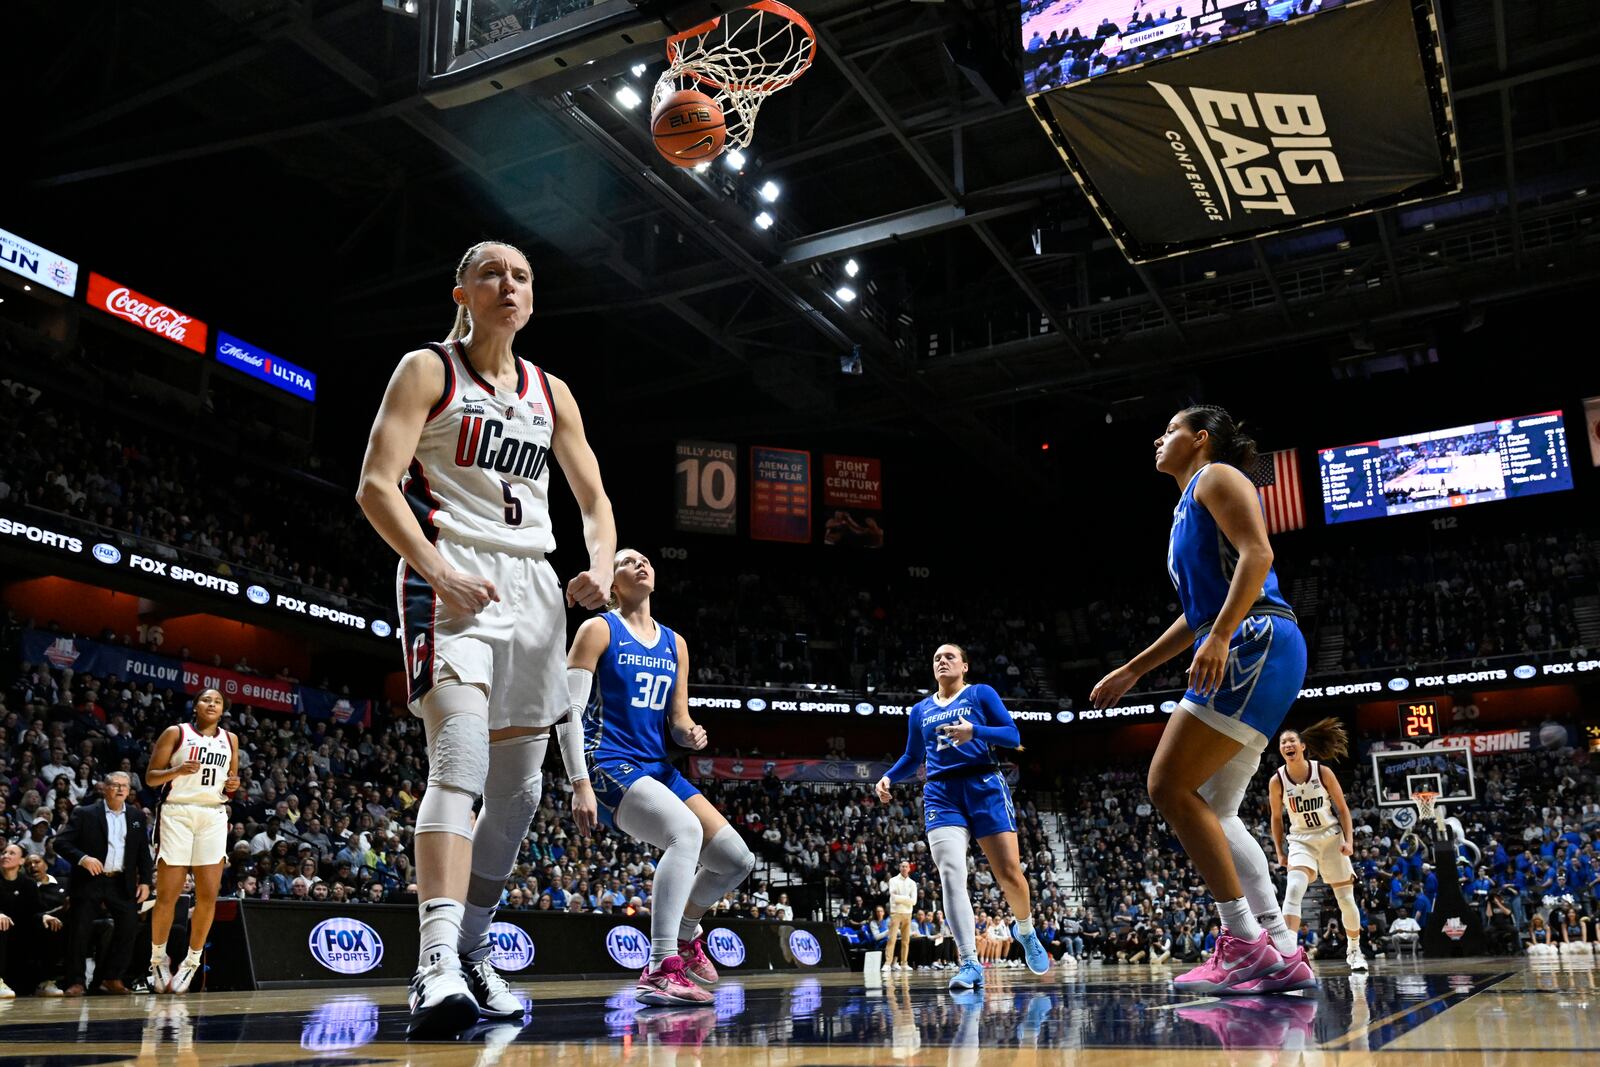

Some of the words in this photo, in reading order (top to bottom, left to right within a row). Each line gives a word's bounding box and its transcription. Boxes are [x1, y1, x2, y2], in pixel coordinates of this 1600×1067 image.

[1129, 30, 1165, 45] CREIGHTON
[1174, 22, 1186, 32] 22
[1255, 92, 1344, 184] BIG
[1189, 87, 1296, 215] EAST
[1165, 130, 1223, 222] CONFERENCE
[106, 287, 192, 342] Coca-Cola
[219, 342, 263, 368] Michelob
[272, 362, 312, 391] ULTRA
[463, 407, 485, 415] CHANGE
[455, 415, 548, 481] UConn
[707, 448, 735, 460] JOEL
[758, 461, 789, 471] ARENA
[790, 463, 803, 472] OF
[760, 469, 777, 479] THE
[778, 471, 803, 481] YEAR
[835, 460, 870, 473] FIGHT
[851, 471, 867, 480] THE
[675, 458, 737, 510] 10
[826, 476, 880, 492] CENTURY
[499, 479, 523, 526] 5
[0, 517, 83, 553] SPORTS
[660, 546, 688, 560] 109
[129, 554, 168, 576] FOX
[170, 565, 240, 595] SPORTS
[908, 566, 930, 578] 110
[276, 594, 307, 614] FOX
[309, 603, 366, 630] SPORTS
[136, 624, 165, 646] 16
[617, 653, 677, 673] CREIGHTON
[1543, 662, 1575, 675] FOX
[125, 659, 179, 681] FOLLOW
[182, 671, 199, 685] US
[203, 676, 221, 690] ON
[242, 683, 299, 705] @BIGEAST
[1415, 675, 1445, 687] FOX
[1447, 669, 1508, 684] SPORTS
[631, 671, 672, 711] 30
[1296, 687, 1323, 699] FOX
[1325, 681, 1382, 697] SPORTS
[688, 697, 742, 709] SPORTS
[771, 701, 797, 711] FOX
[799, 701, 851, 713] SPORTS
[879, 705, 903, 715] FOX
[1079, 709, 1103, 720] FOX
[1105, 704, 1155, 718] SPORTS
[1409, 704, 1434, 716] 7:01
[921, 707, 972, 728] CREIGHTON
[1451, 704, 1480, 721] 20
[1407, 716, 1433, 736] 24
[935, 720, 961, 752] 2
[1473, 731, 1531, 753] SHINE
[201, 768, 217, 787] 21
[1288, 795, 1324, 813] UConn
[1303, 812, 1322, 828] 20
[324, 929, 368, 952] FOX
[488, 932, 523, 952] FOX
[615, 934, 640, 952] FOX
[714, 935, 736, 952] FOX
[796, 937, 814, 953] FOX
[328, 952, 371, 962] SPORTS
[619, 951, 645, 960] SPORTS
